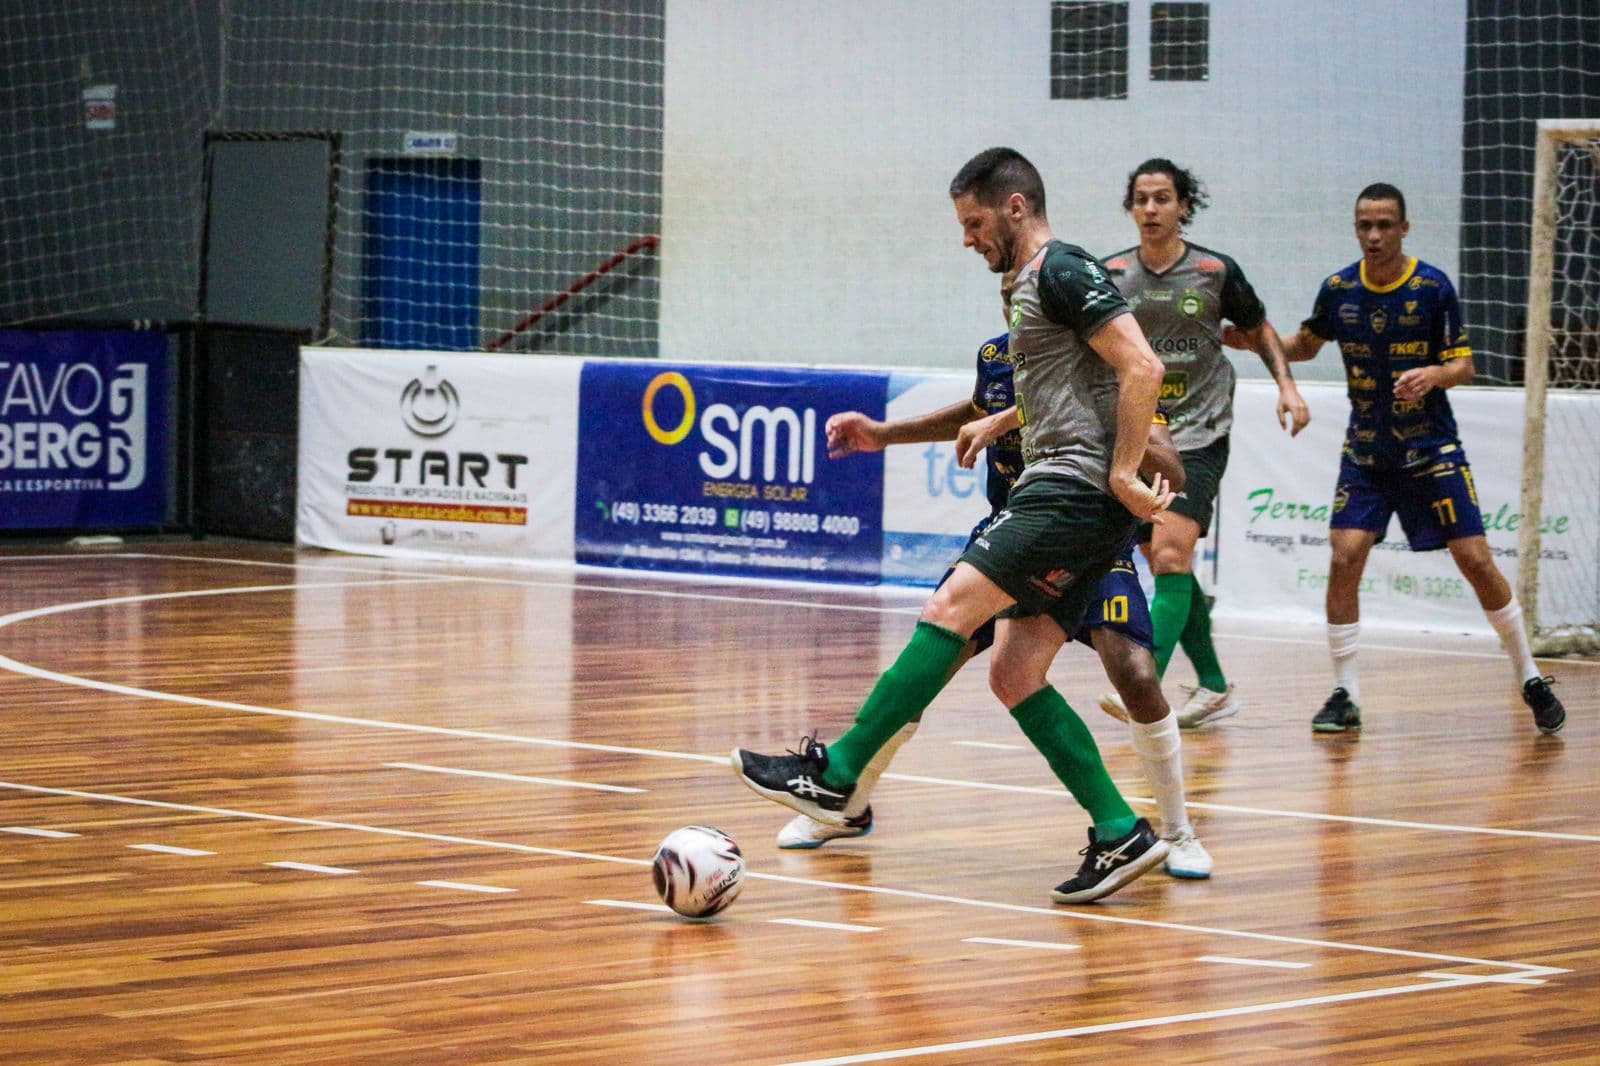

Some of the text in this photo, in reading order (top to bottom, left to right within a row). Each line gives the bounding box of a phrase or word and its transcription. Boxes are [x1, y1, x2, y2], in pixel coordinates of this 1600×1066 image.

[1151, 337, 1198, 352] COOB
[347, 447, 529, 490] START
[703, 481, 808, 502] ENERGIA SOLAR
[611, 501, 640, 525] (49)
[1247, 487, 1328, 524] Ferra
[741, 510, 770, 534] (49)
[821, 515, 860, 536] 4000
[1103, 595, 1128, 623] 10
